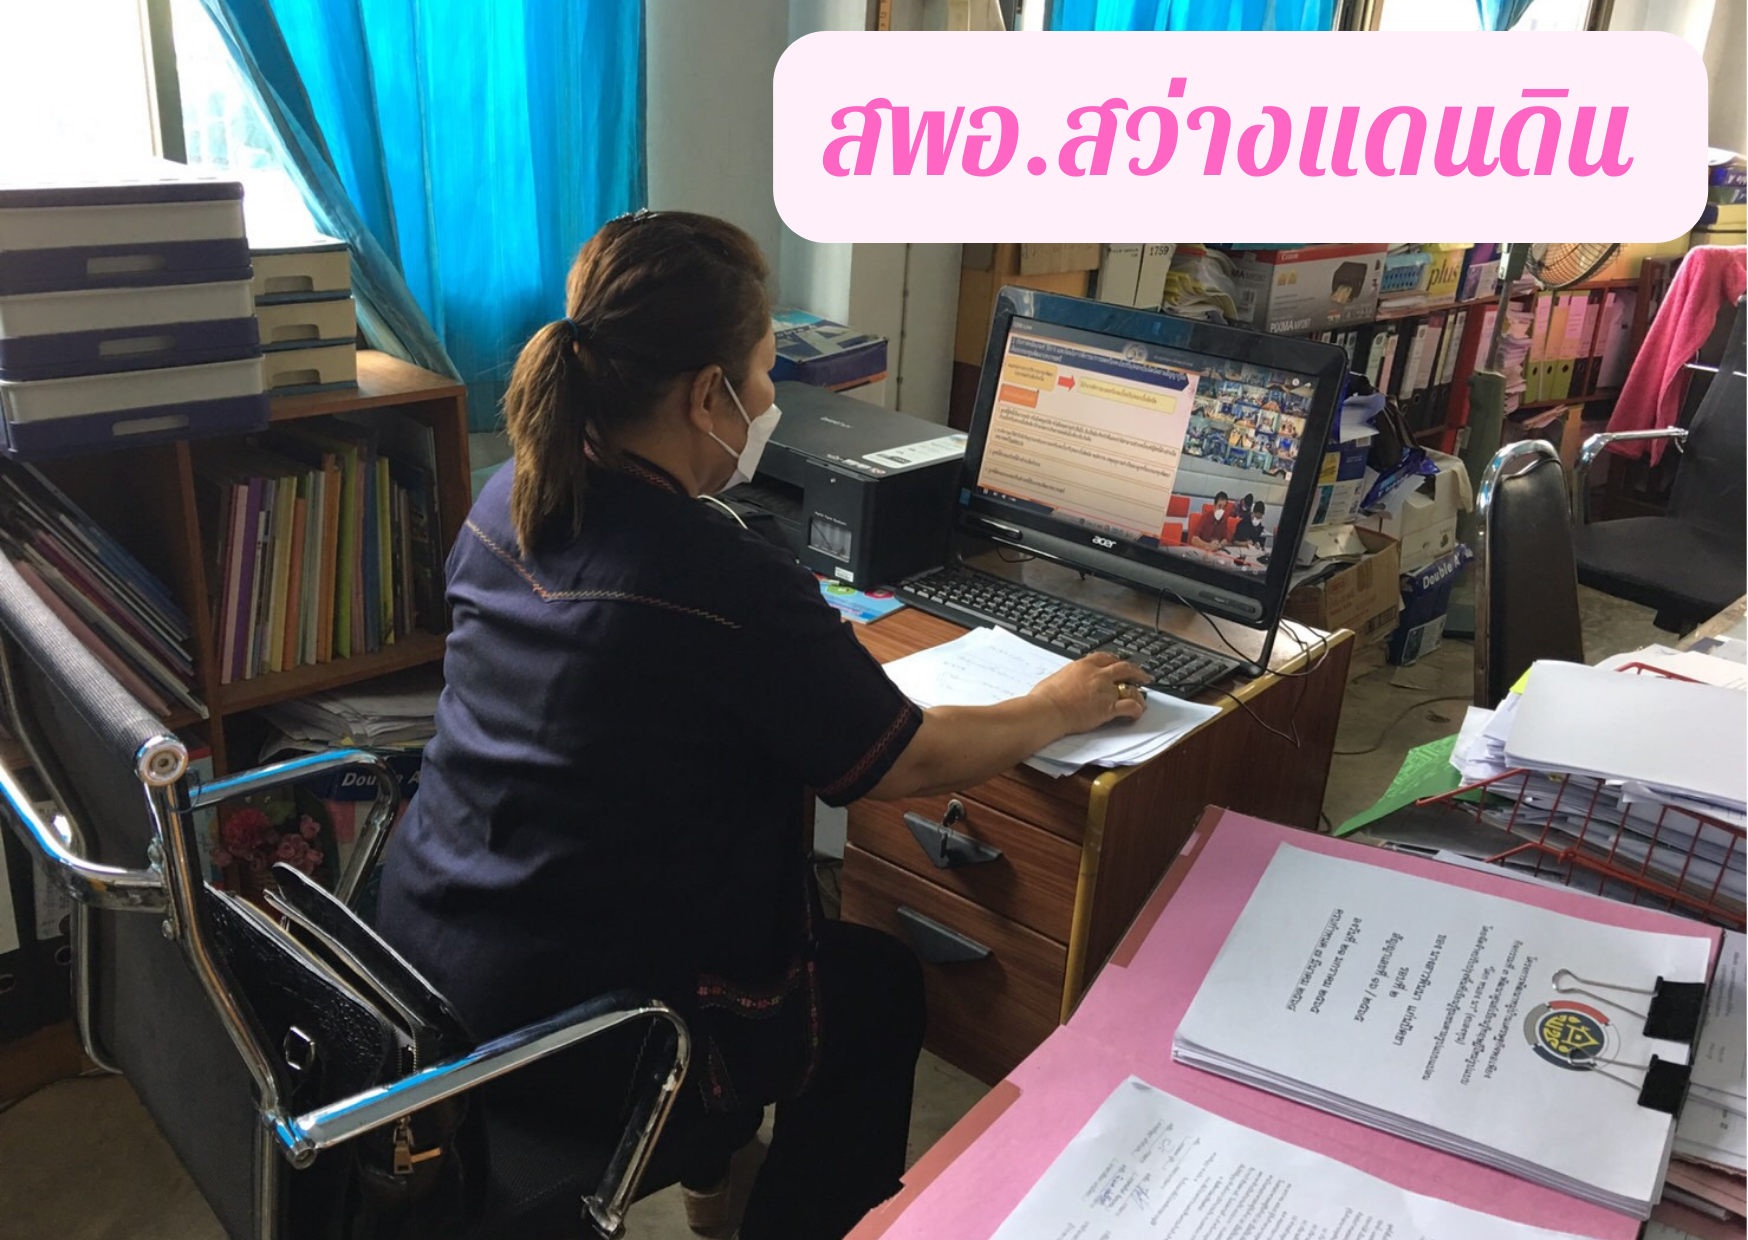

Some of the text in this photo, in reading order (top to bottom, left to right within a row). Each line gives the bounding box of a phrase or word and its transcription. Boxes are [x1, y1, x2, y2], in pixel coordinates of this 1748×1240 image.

[1148, 245, 1170, 257] 1759
[1428, 259, 1461, 288] plus
[1269, 320, 1294, 334] PIXMA
[1092, 535, 1117, 549] acer
[1422, 554, 1461, 589] Double A
[341, 772, 404, 787] Doue
